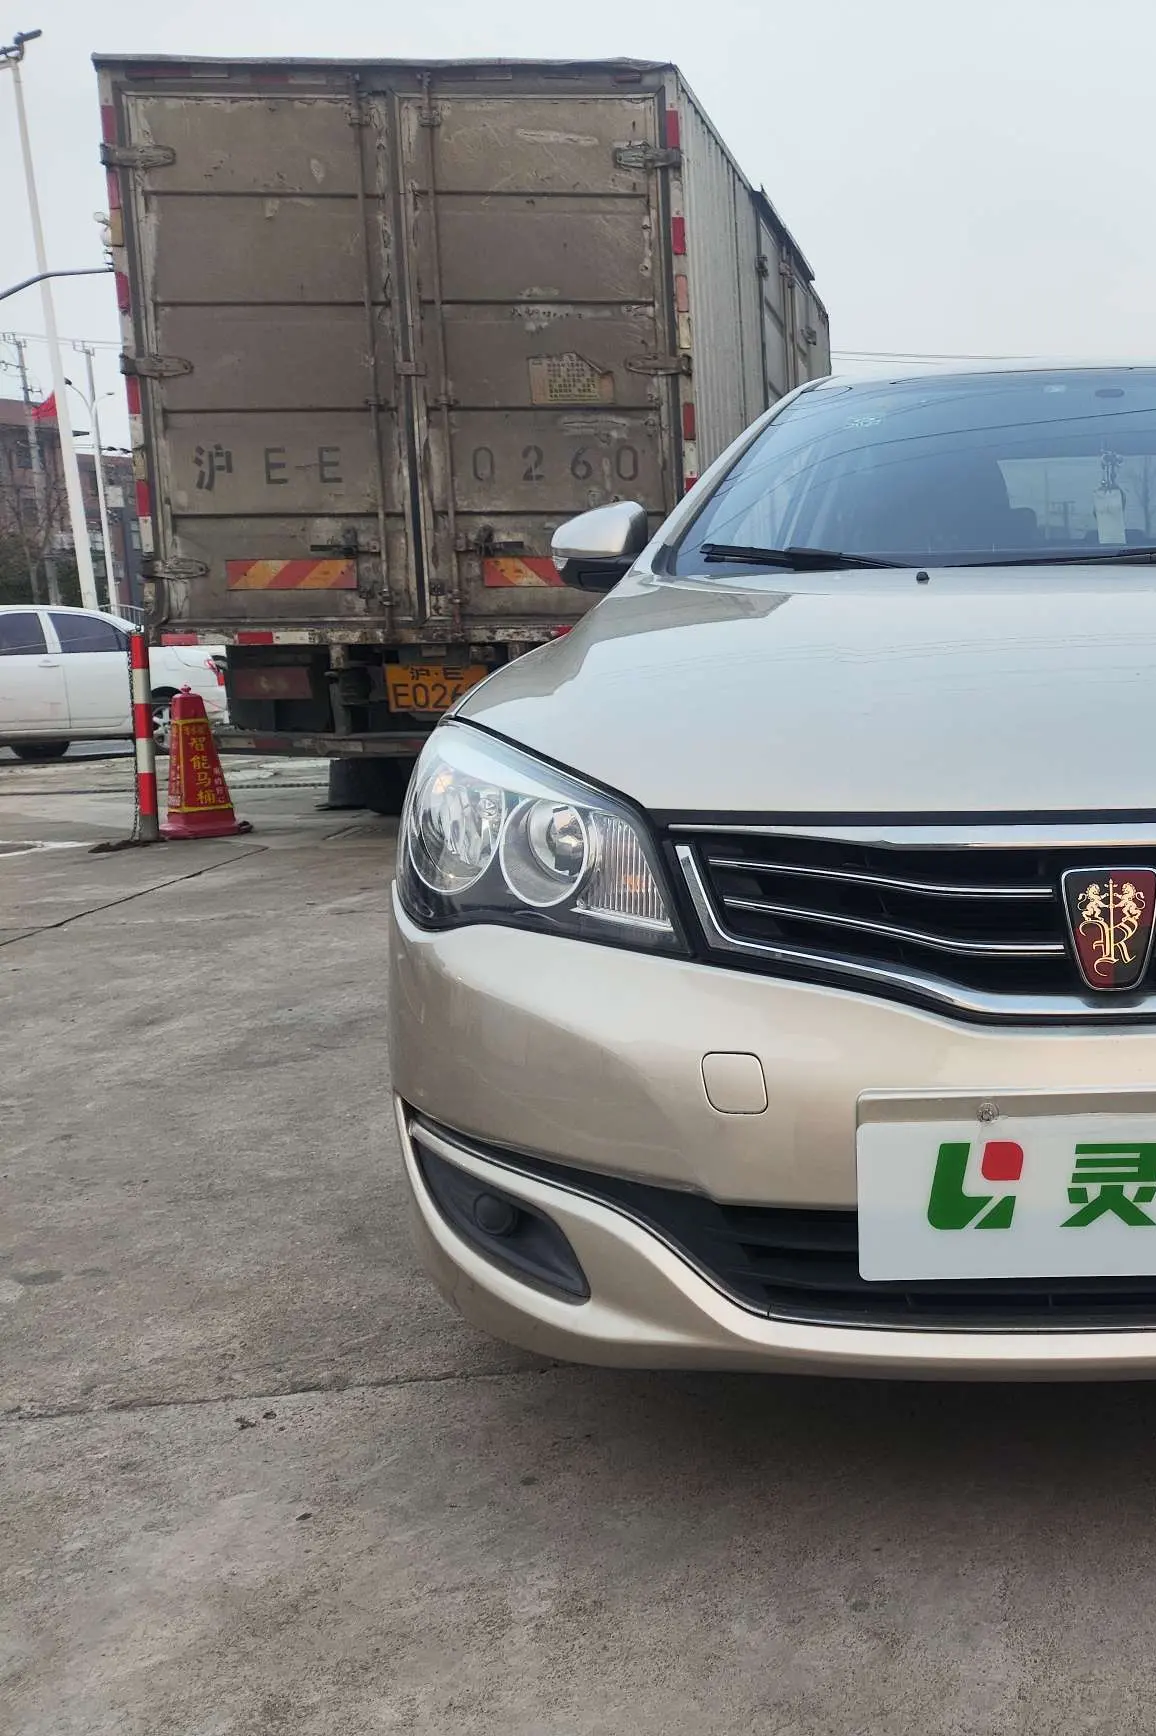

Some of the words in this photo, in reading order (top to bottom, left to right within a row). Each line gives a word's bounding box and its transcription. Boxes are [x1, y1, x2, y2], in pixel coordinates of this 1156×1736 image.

[473, 445, 640, 482] 0260
[188, 736, 216, 804] 智能马桶
